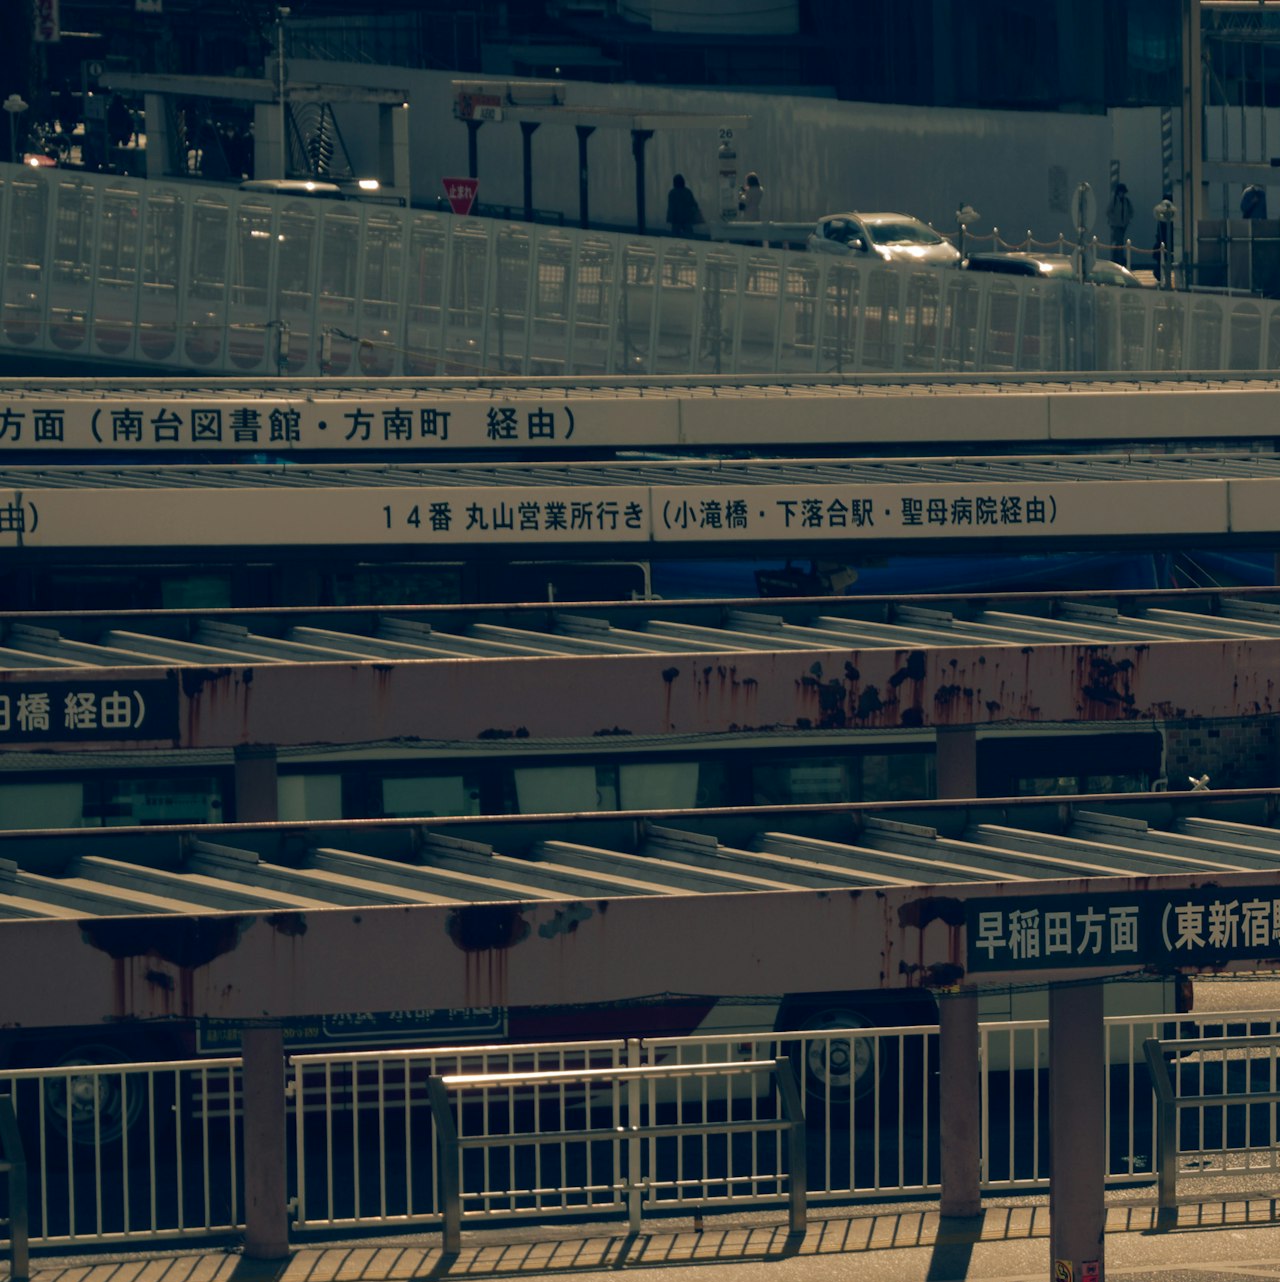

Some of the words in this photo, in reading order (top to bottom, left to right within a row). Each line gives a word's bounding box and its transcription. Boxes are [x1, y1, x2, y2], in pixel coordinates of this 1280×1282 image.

[719, 129, 733, 139] 26
[449, 184, 472, 199] 止まれ
[64, 690, 146, 730] 経由）
